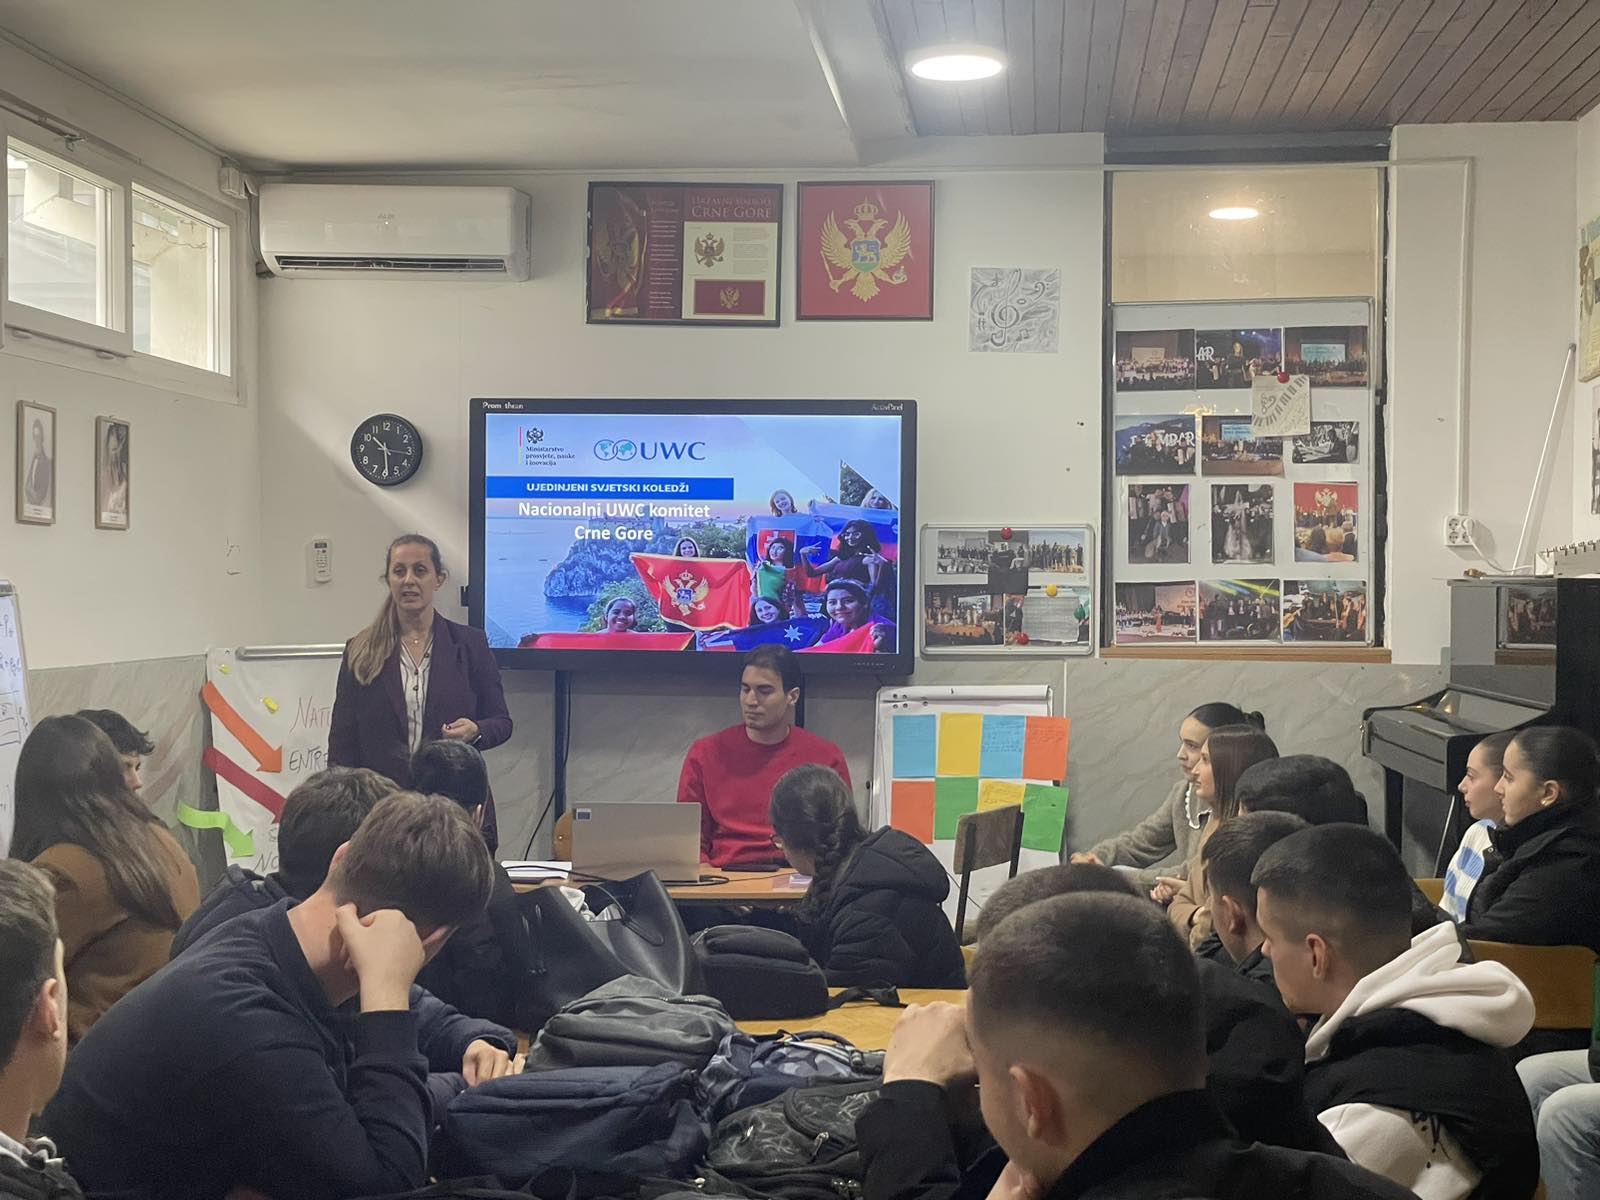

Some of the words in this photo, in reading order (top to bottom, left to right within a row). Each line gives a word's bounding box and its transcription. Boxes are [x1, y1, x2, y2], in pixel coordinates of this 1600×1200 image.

[692, 207, 731, 218] CRNE
[733, 207, 772, 218] GORE
[482, 401, 524, 409] Promthean
[640, 441, 706, 461] UWC
[526, 482, 589, 492] UJEDINJENI
[590, 483, 641, 493] SVJETSKI
[643, 481, 690, 493] KOLEDŽI
[518, 501, 602, 517] Nacionalni
[606, 503, 645, 518] UWC
[649, 502, 711, 518] komitet
[574, 525, 611, 540] Crne
[615, 525, 653, 541] Gore
